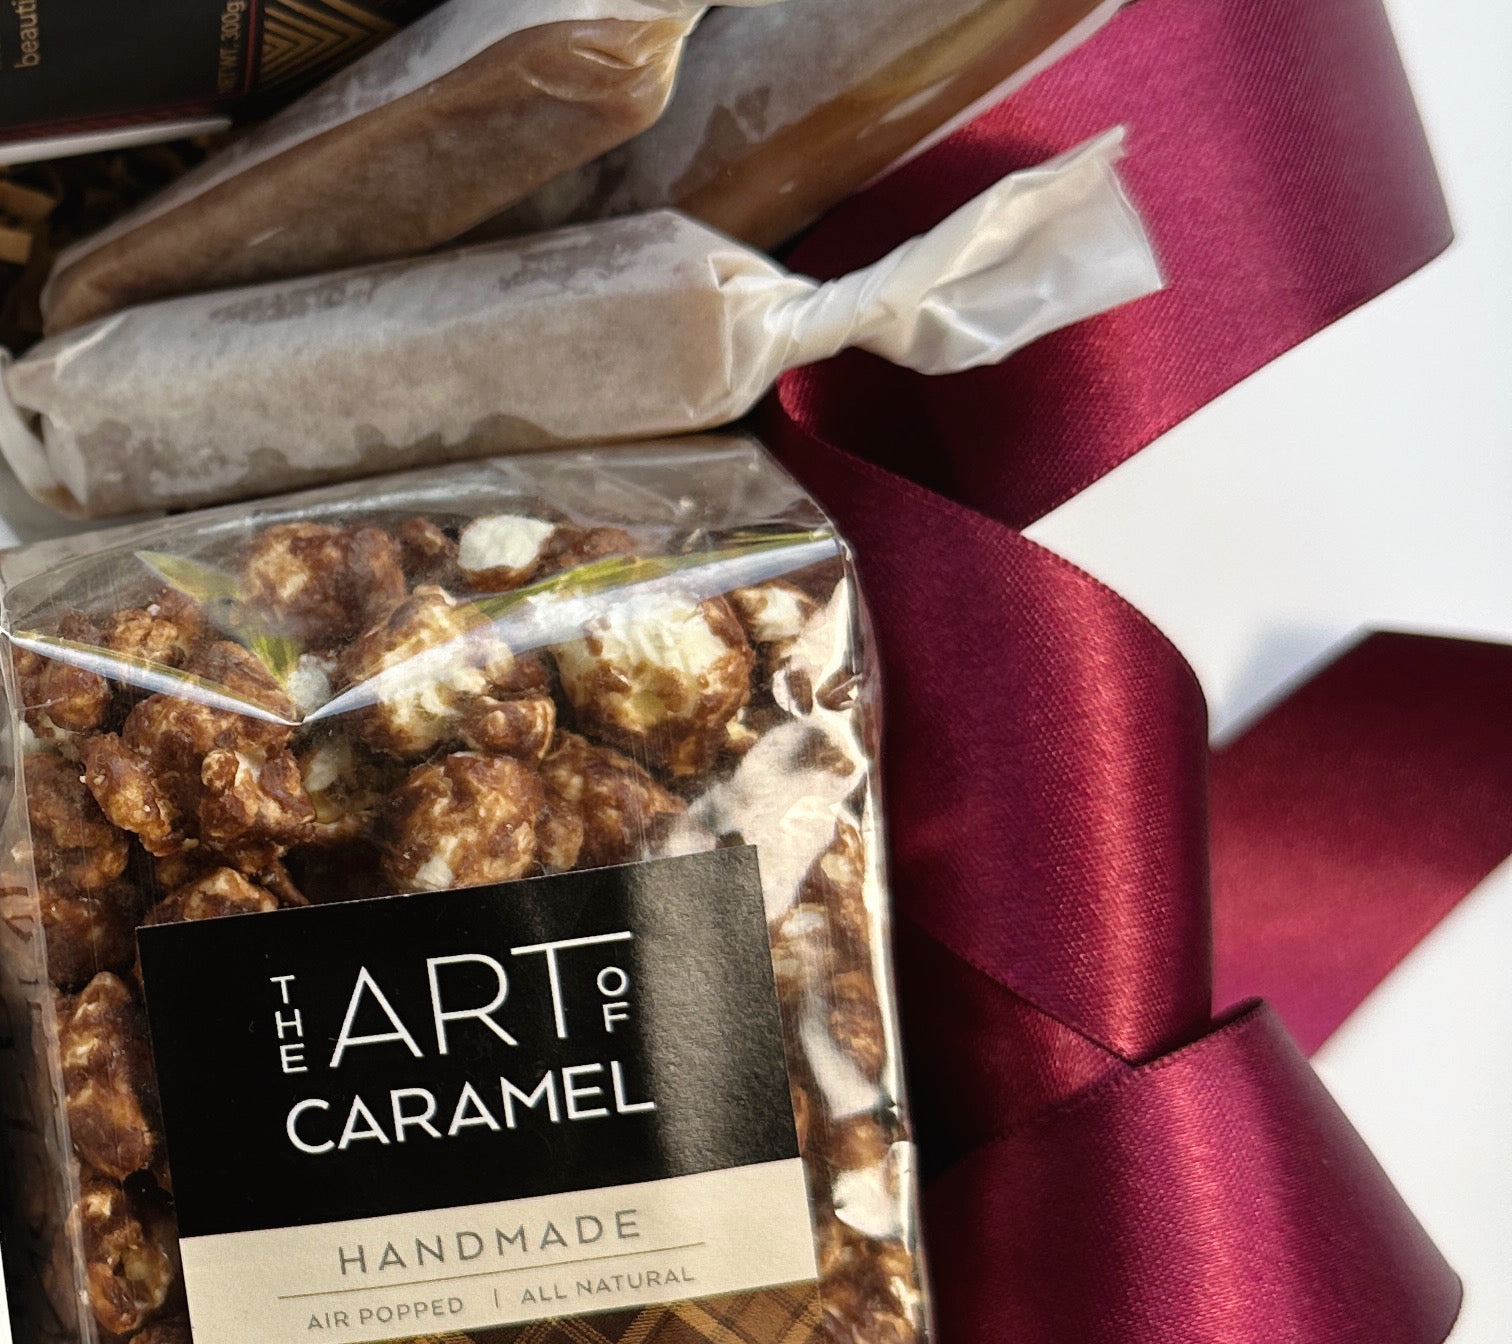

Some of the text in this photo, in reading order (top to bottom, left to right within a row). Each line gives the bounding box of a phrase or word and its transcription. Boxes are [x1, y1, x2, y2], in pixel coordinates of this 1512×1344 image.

[220, 1, 246, 40] 300g
[270, 930, 633, 1073] THE ART OF
[286, 1060, 656, 1154] CARAMEL
[338, 1208, 641, 1276] HANDMADE
[307, 1265, 695, 1331] AIR POPPED ALL NATURAL
